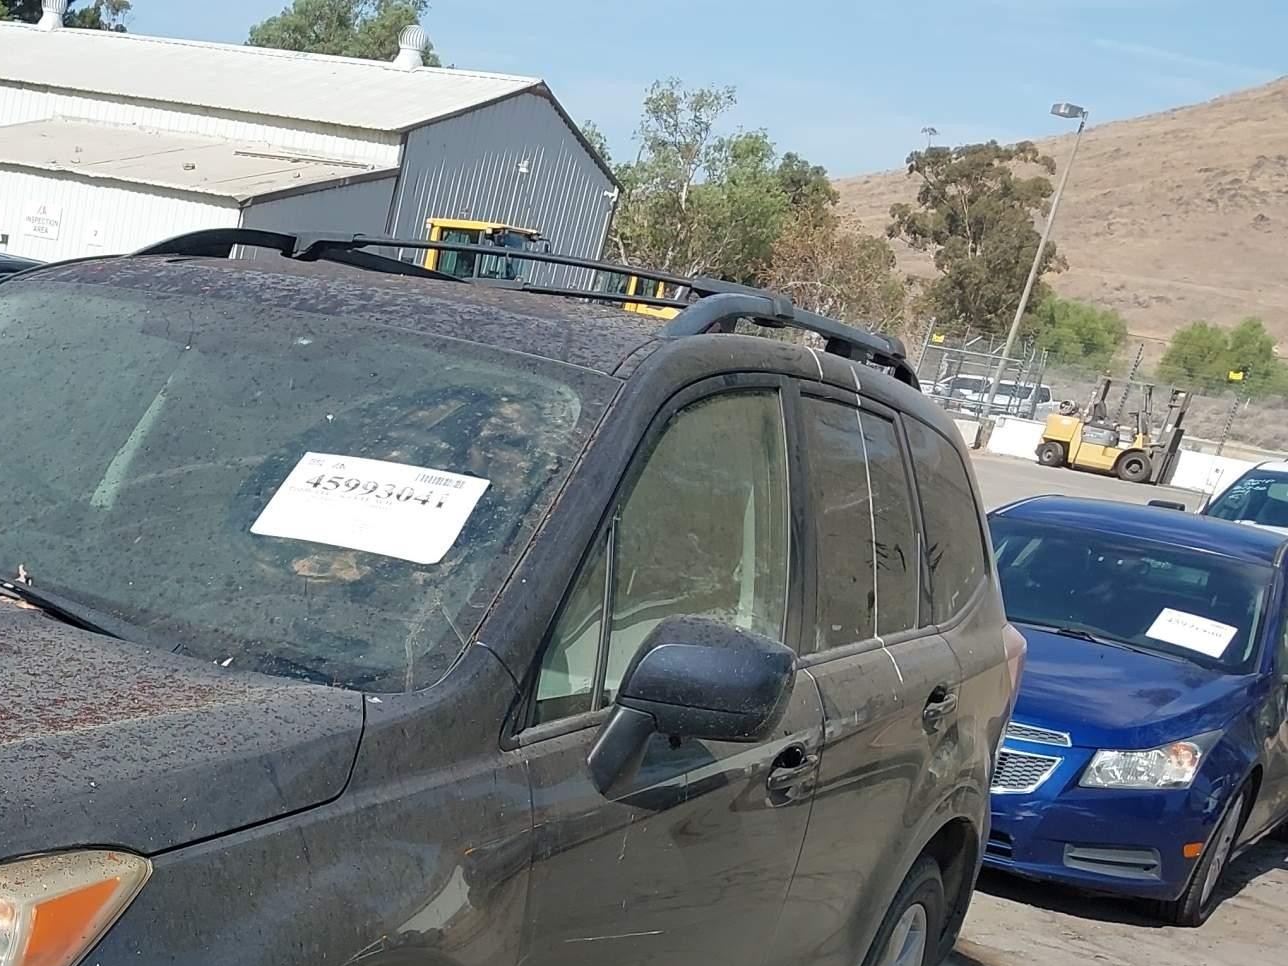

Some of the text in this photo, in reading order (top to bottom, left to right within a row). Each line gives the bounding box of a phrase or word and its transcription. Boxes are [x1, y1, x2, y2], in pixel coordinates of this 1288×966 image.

[25, 216, 59, 227] INSPECTION
[32, 226, 49, 234] AREA
[305, 473, 450, 509] 45993041
